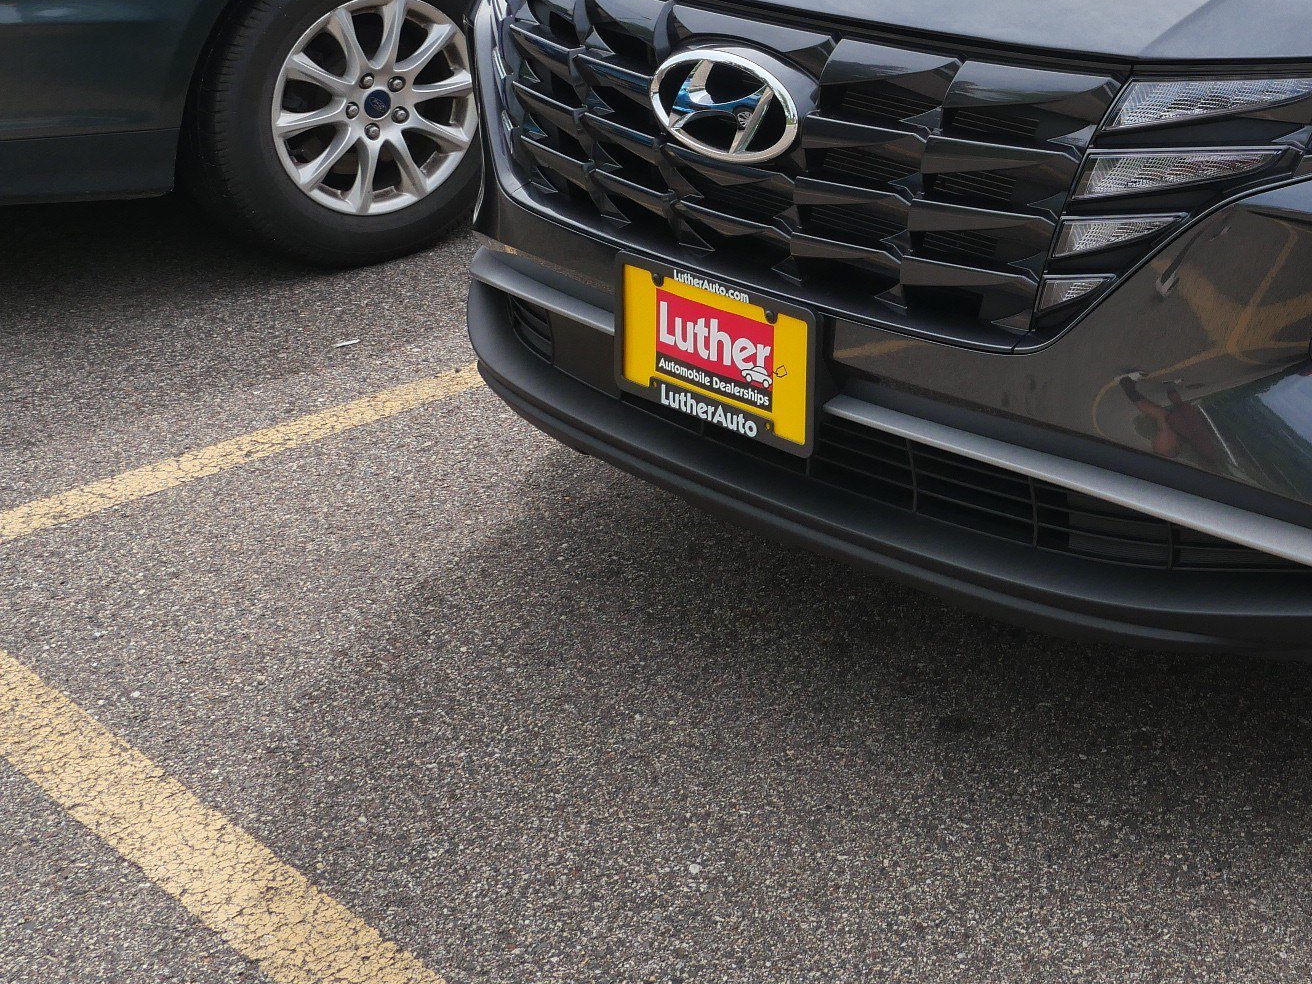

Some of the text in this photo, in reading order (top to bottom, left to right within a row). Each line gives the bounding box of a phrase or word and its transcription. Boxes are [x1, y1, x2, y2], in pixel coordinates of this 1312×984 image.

[673, 269, 749, 303] LutherAuto.com
[659, 301, 771, 373] Luther
[658, 357, 769, 406] Automobile Dealerships
[660, 384, 757, 437] LutherAuto
